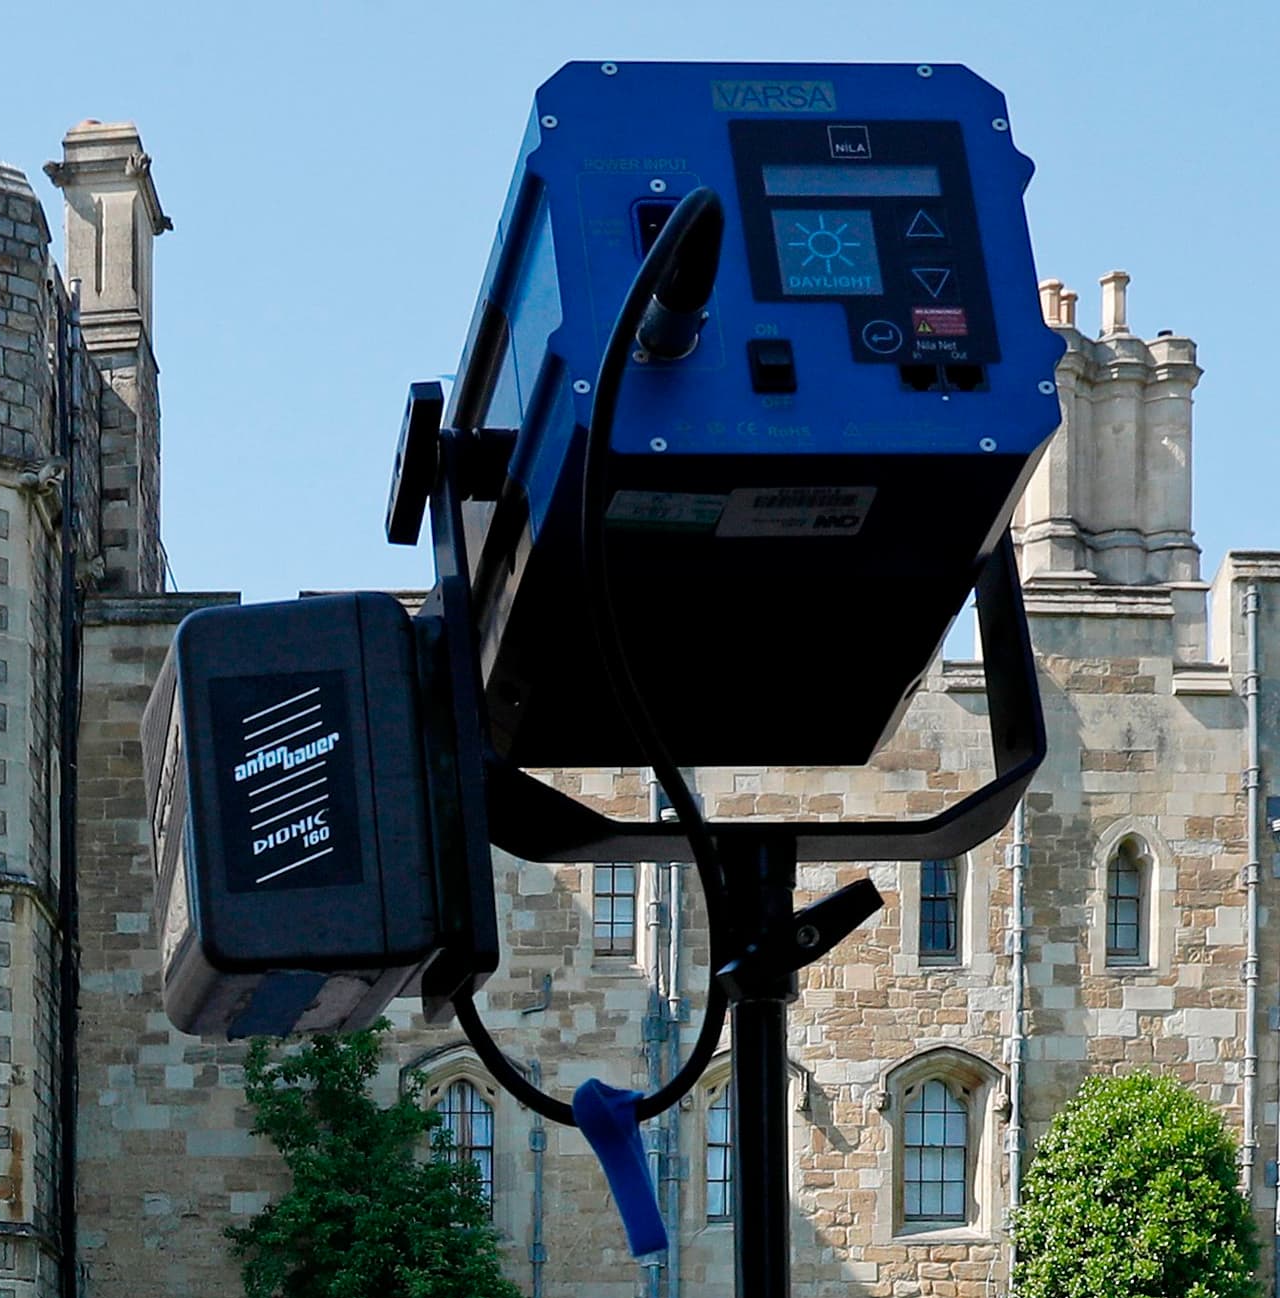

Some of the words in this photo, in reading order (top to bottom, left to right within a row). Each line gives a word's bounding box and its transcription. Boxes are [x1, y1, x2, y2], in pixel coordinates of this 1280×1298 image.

[716, 85, 833, 109] VARSA
[835, 143, 867, 153] NILA
[584, 158, 640, 170] POWER
[643, 158, 688, 170] INPUT
[789, 275, 873, 289] DAYLIGHT
[754, 322, 780, 336] ON
[761, 397, 793, 409] OFF
[253, 808, 328, 856] DIONIC
[303, 826, 330, 848] 160
